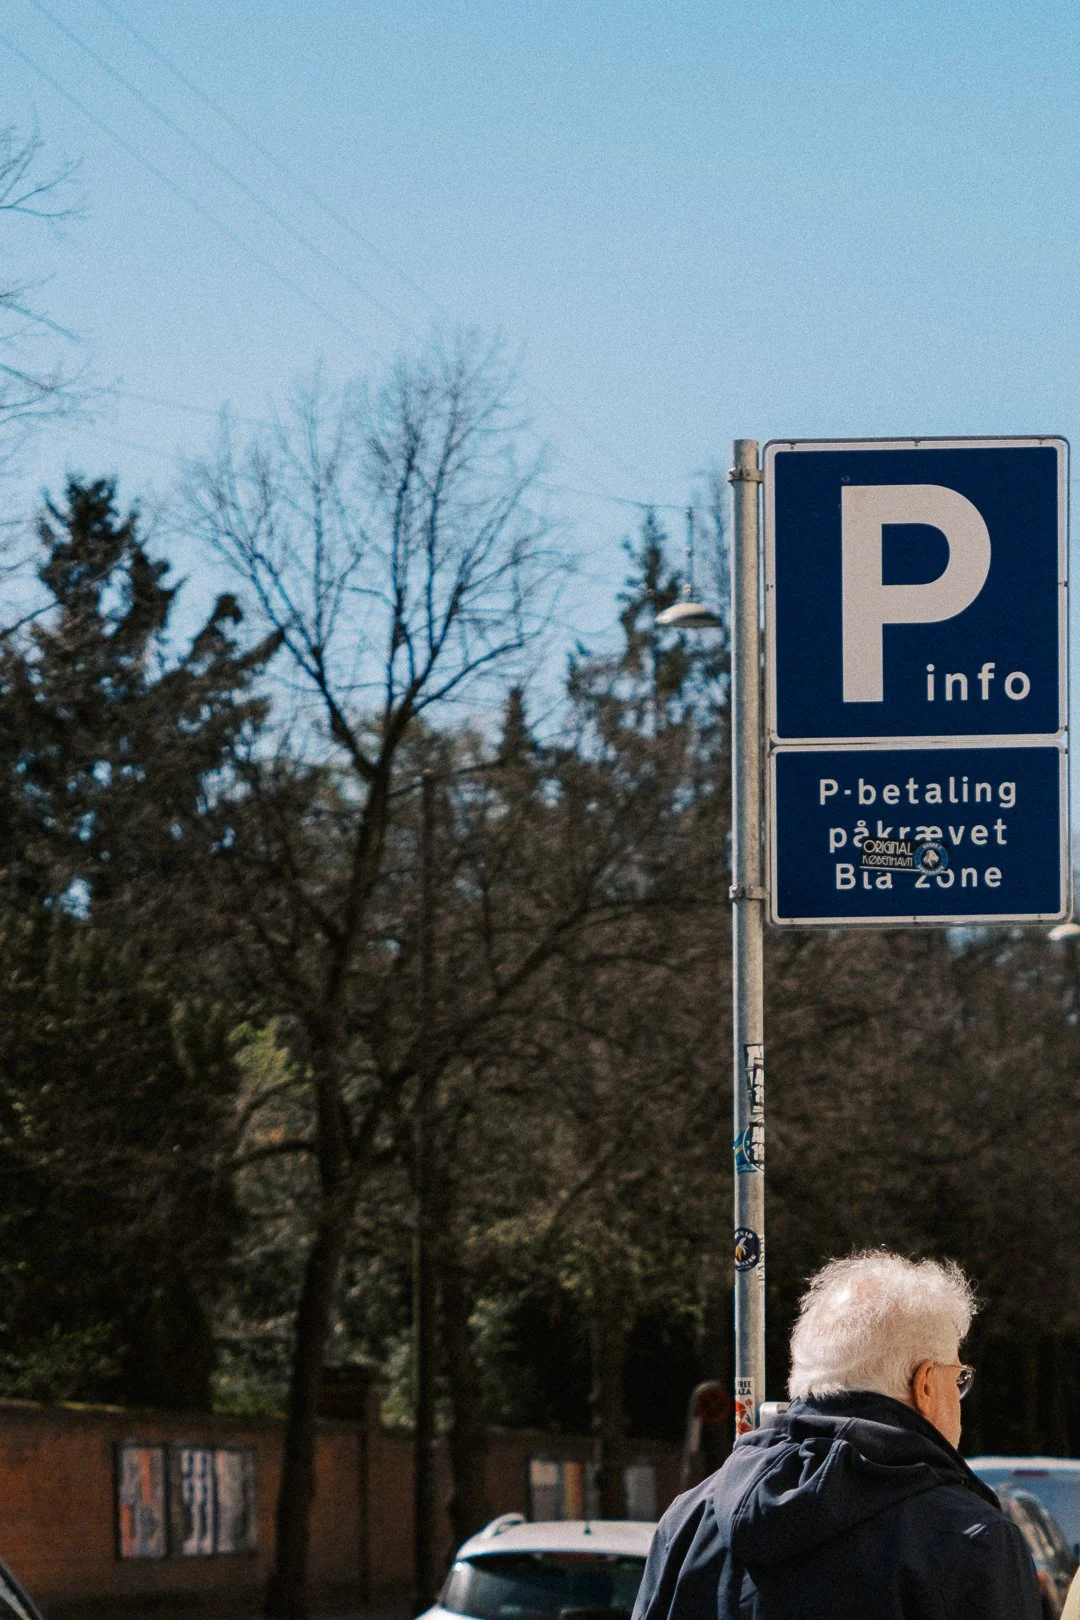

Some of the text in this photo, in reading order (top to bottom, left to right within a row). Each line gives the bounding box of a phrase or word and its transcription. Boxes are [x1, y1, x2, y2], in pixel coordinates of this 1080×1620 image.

[841, 484, 991, 702] P
[926, 662, 1031, 701] info
[819, 776, 1016, 808] P-betaling
[829, 818, 1007, 853] påkrævet
